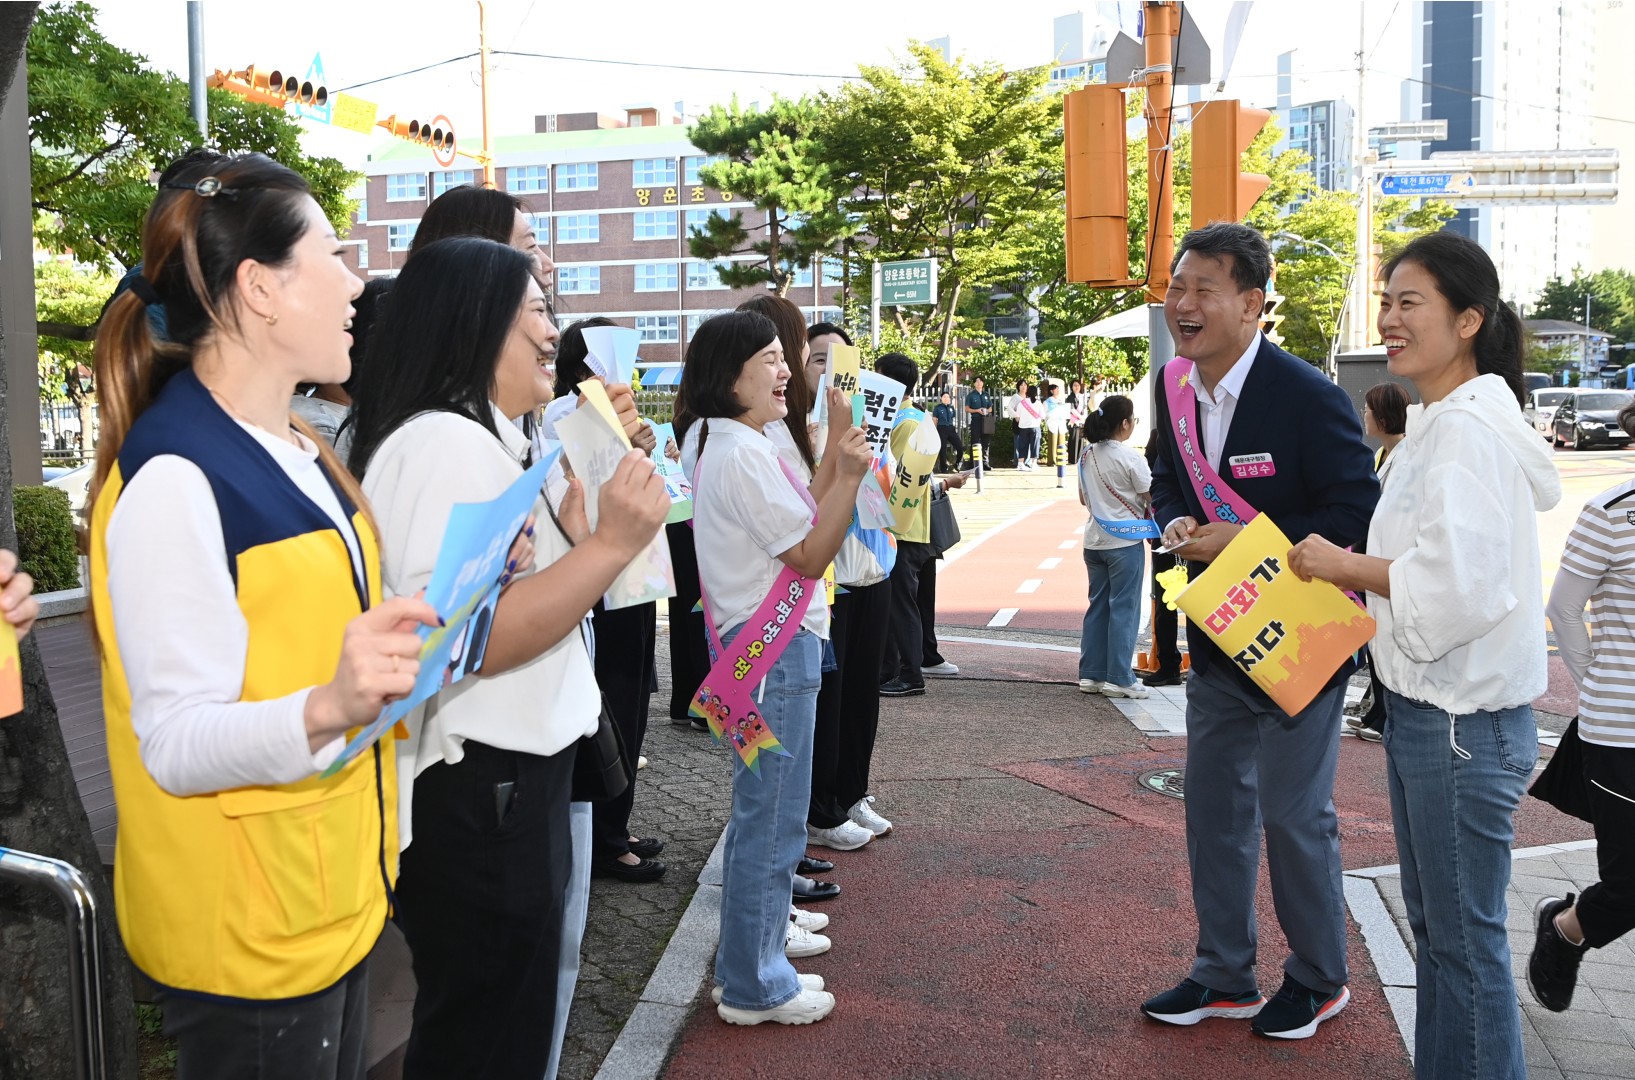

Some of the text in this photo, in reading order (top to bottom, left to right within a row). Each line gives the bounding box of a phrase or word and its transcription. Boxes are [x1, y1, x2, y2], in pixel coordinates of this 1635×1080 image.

[884, 266, 928, 282] 양운초등학교
[859, 388, 898, 421] 력은
[1235, 464, 1271, 477] 김성수
[1203, 556, 1282, 636] 대화가
